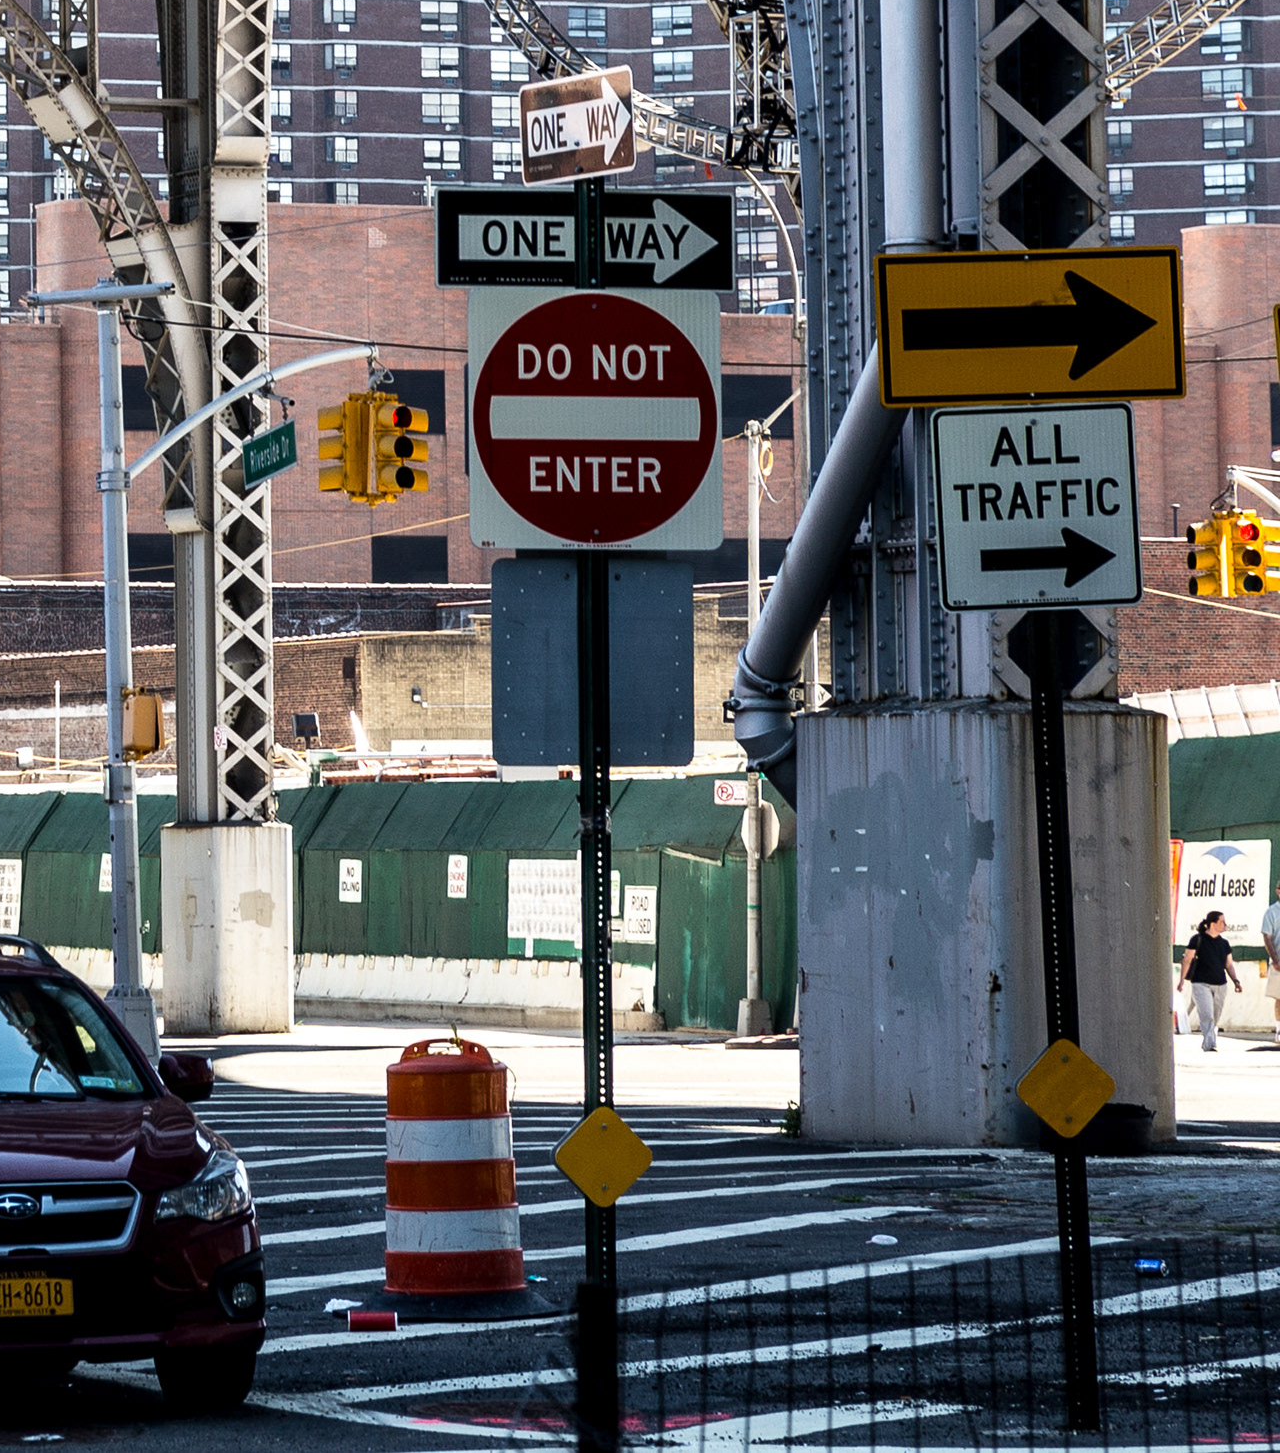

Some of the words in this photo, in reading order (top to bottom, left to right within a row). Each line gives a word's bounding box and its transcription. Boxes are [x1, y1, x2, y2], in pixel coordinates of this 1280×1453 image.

[531, 112, 568, 152] ONE
[586, 102, 620, 143] WAY
[482, 220, 566, 257] ONE
[606, 222, 690, 260] WAY
[518, 343, 572, 380] DO
[592, 344, 671, 381] NOT
[250, 440, 280, 474] Riverside
[281, 435, 290, 459] Dr
[990, 424, 1081, 467] ALL
[529, 456, 662, 493] ENTER
[953, 477, 1121, 522] TRAFFIC
[342, 881, 360, 892] IDLING
[346, 867, 355, 877] NO
[1187, 873, 1217, 897] Lend
[1221, 873, 1256, 897] Lease
[631, 896, 649, 911] ROAD
[627, 918, 652, 934] CLOSED
